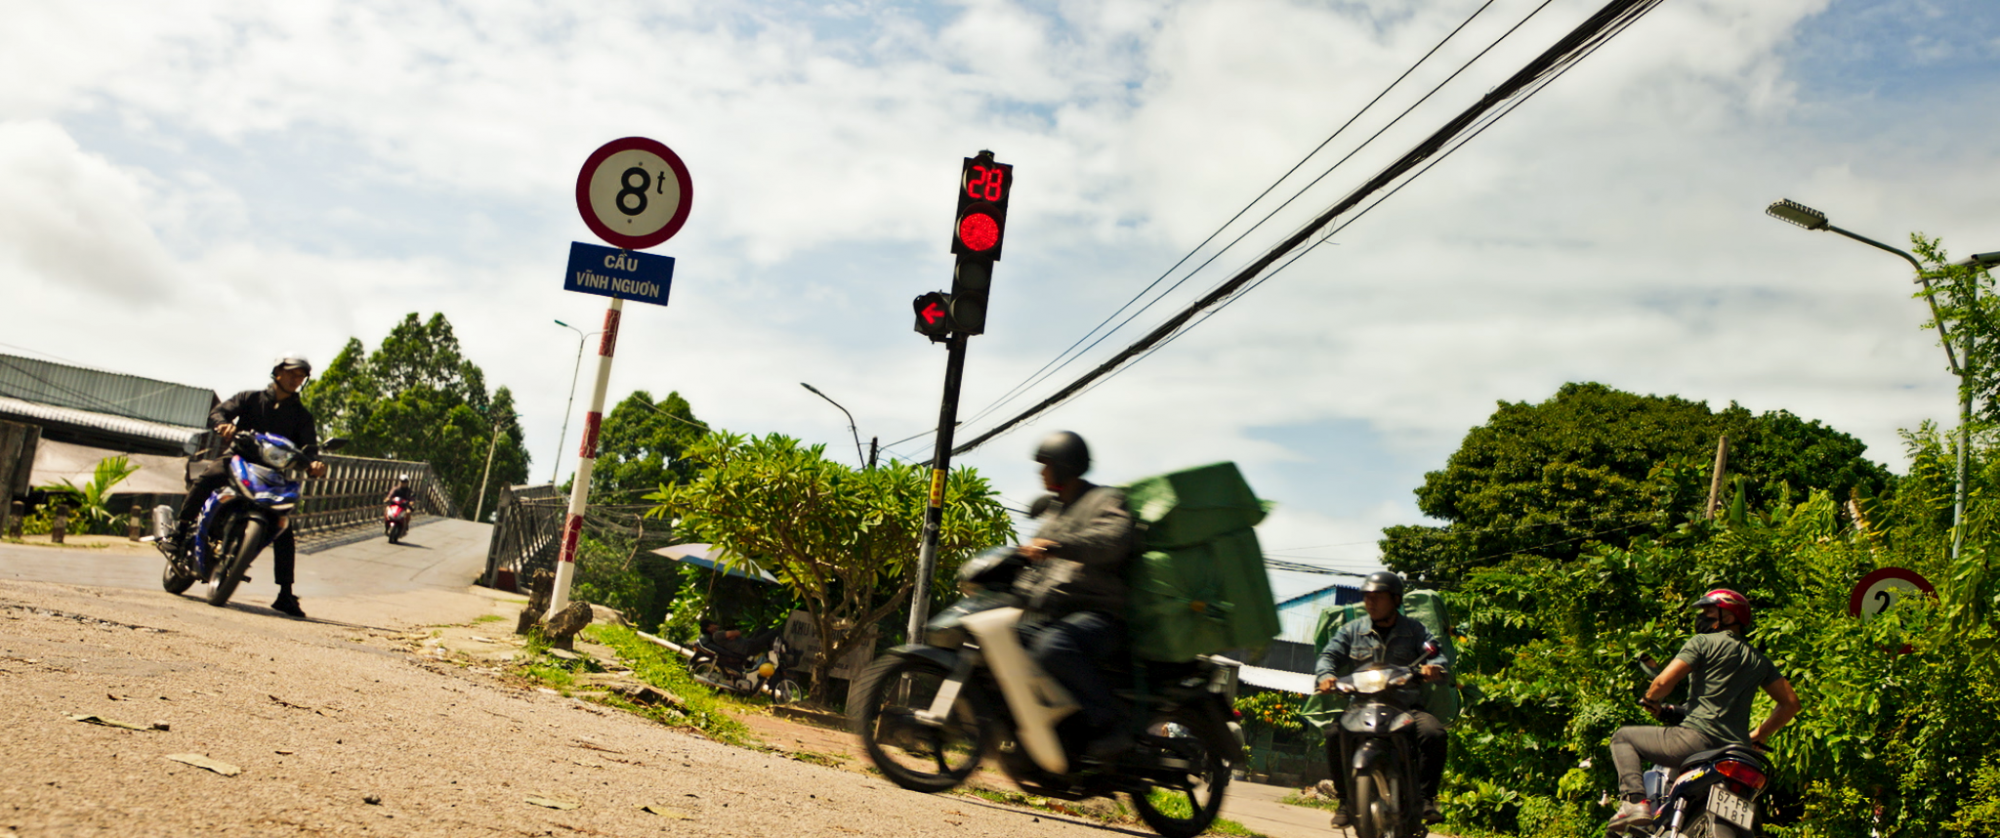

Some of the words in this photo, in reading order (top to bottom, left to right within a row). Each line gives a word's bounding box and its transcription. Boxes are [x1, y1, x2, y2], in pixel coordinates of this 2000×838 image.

[967, 165, 1004, 202] 28
[604, 252, 639, 272] CẦU
[576, 269, 610, 291] VĨNH
[1717, 789, 1749, 813] 67-F8
[1716, 801, 1745, 826] 1181
